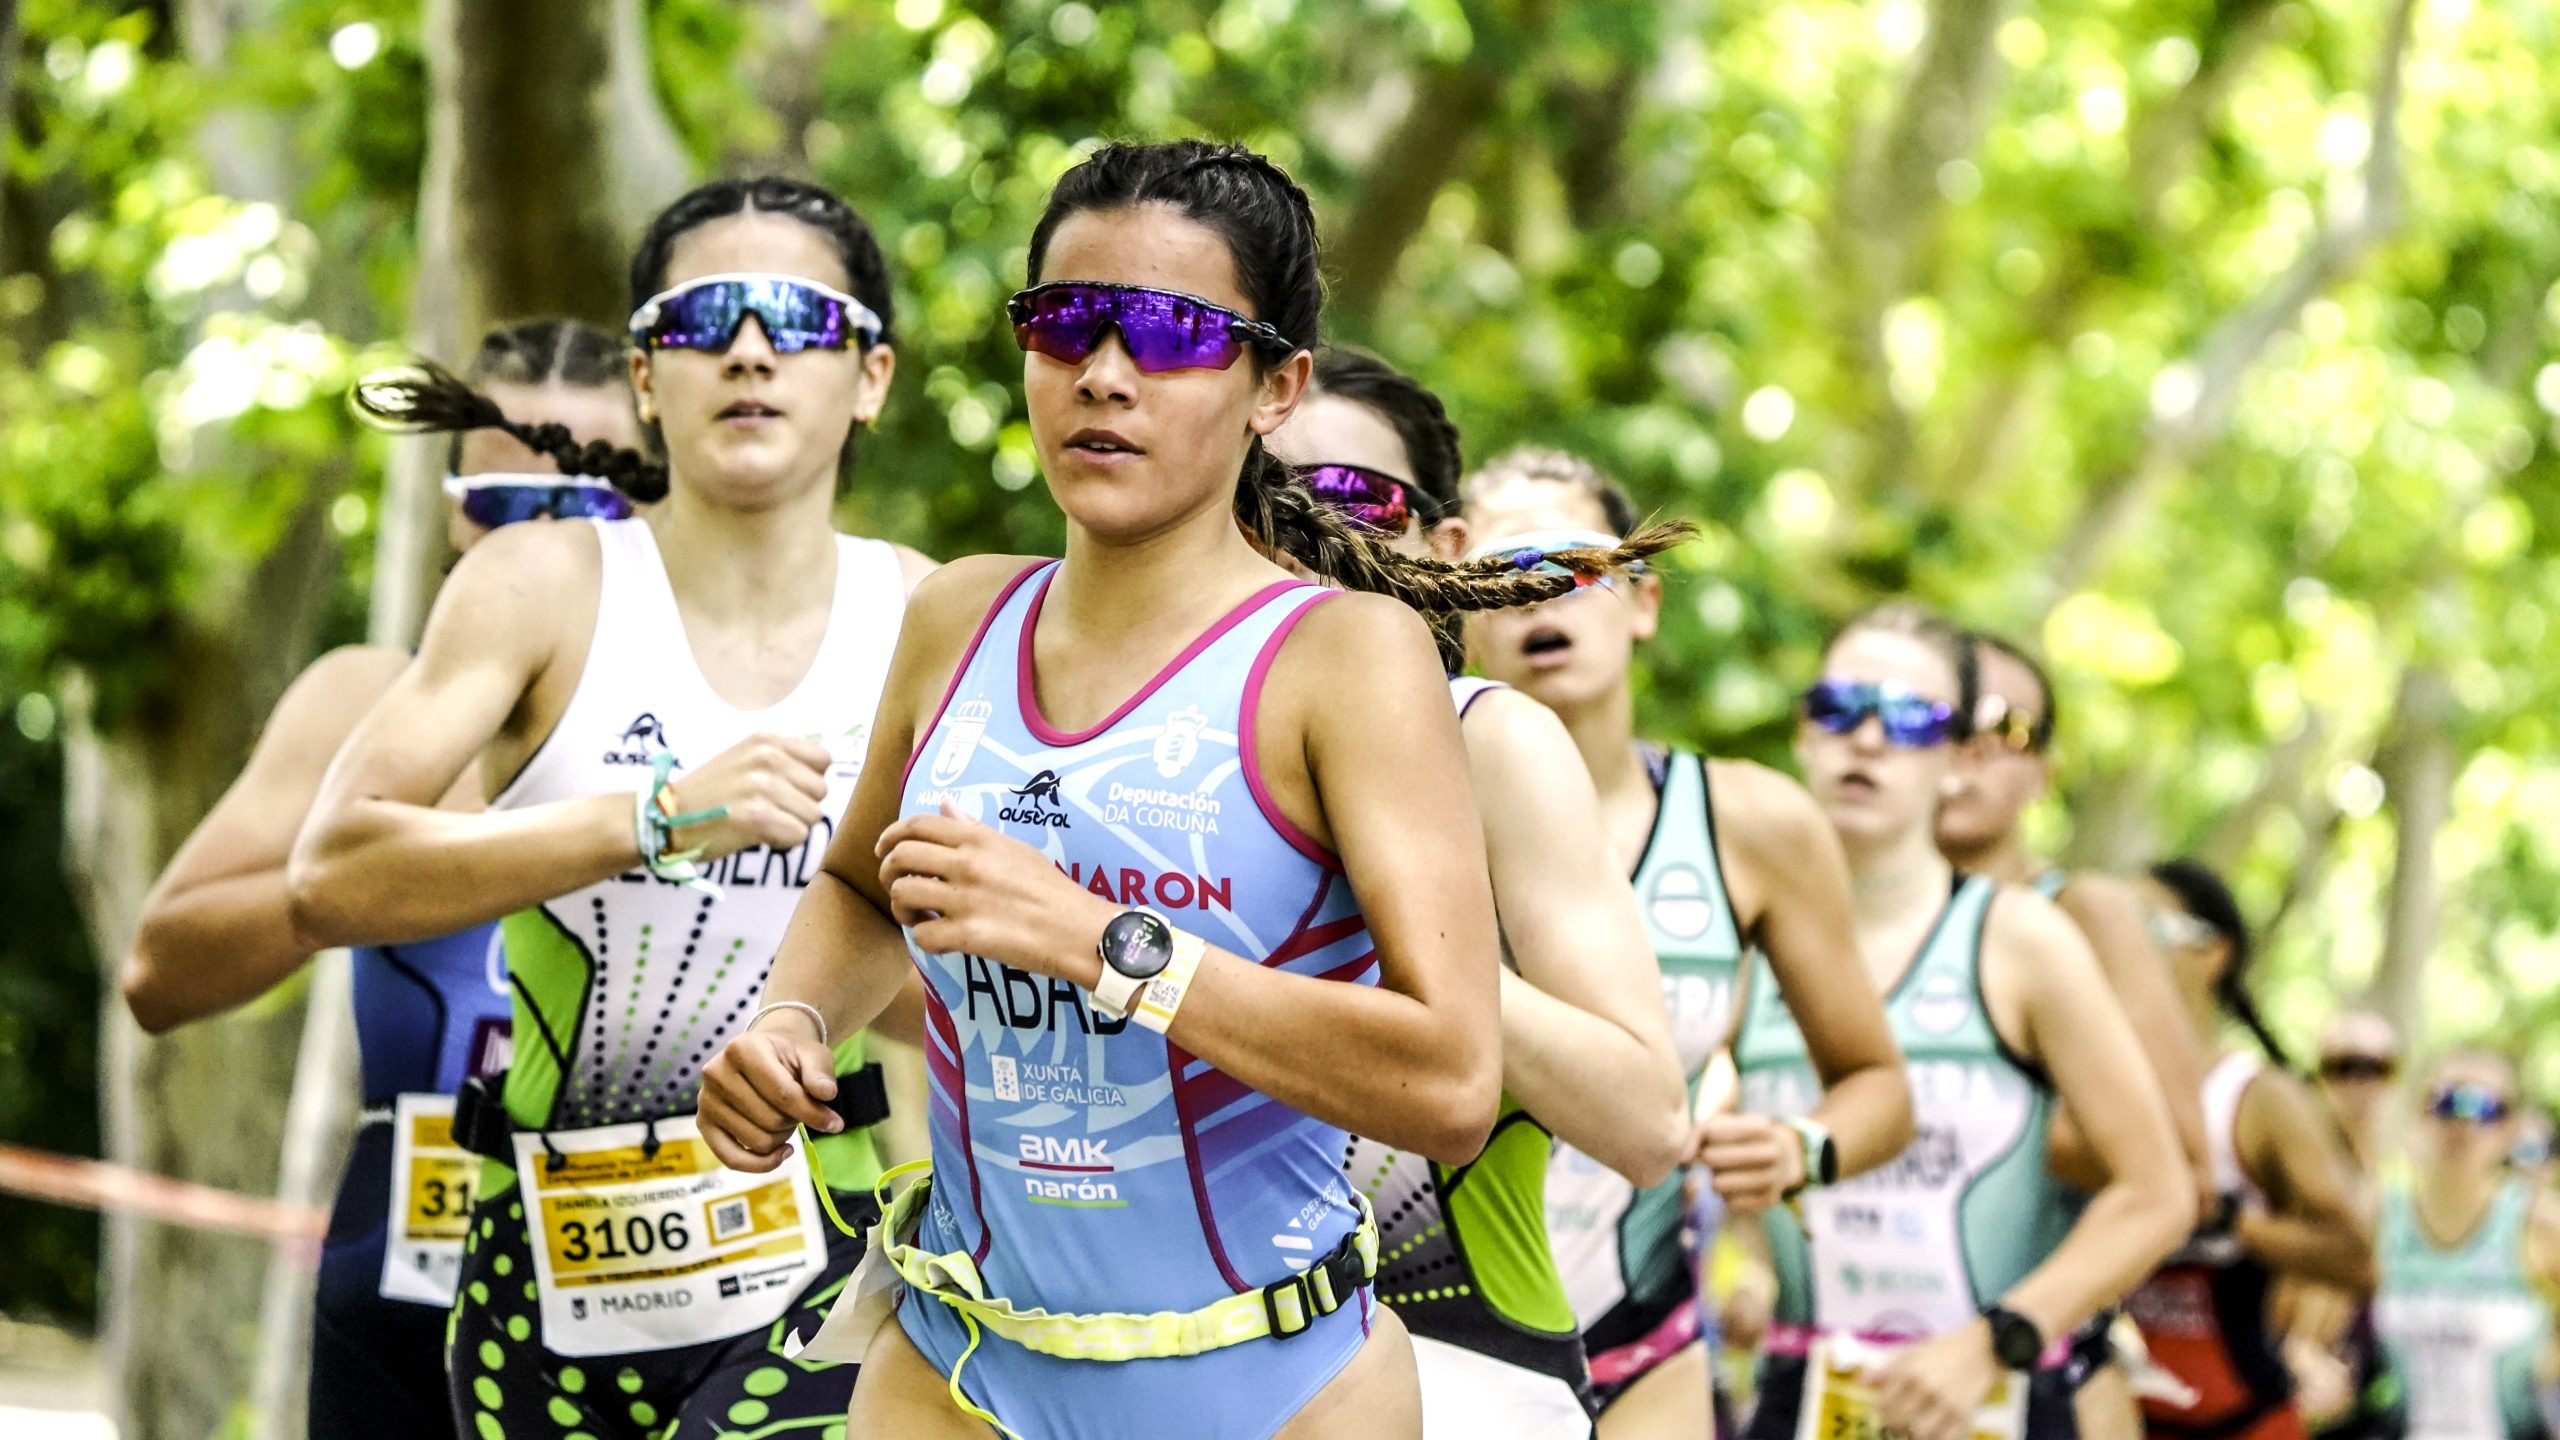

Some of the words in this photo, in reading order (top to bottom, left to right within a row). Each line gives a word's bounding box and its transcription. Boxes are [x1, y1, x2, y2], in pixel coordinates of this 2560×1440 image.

[1109, 782, 1220, 815] Deputación
[999, 807, 1071, 829] austral
[1105, 804, 1135, 825] DA
[1140, 803, 1219, 835] CORUÑA
[963, 953, 1128, 1036] ABA
[1023, 1063, 1082, 1083] XUNTA
[1024, 1083, 1048, 1102] DE
[1050, 1085, 1125, 1106] GALICIA
[1019, 1134, 1112, 1164] BMK
[421, 1179, 475, 1217] 31
[1025, 1178, 1118, 1201] narón
[560, 1212, 691, 1262] 3106
[601, 1289, 693, 1315] MADRID
